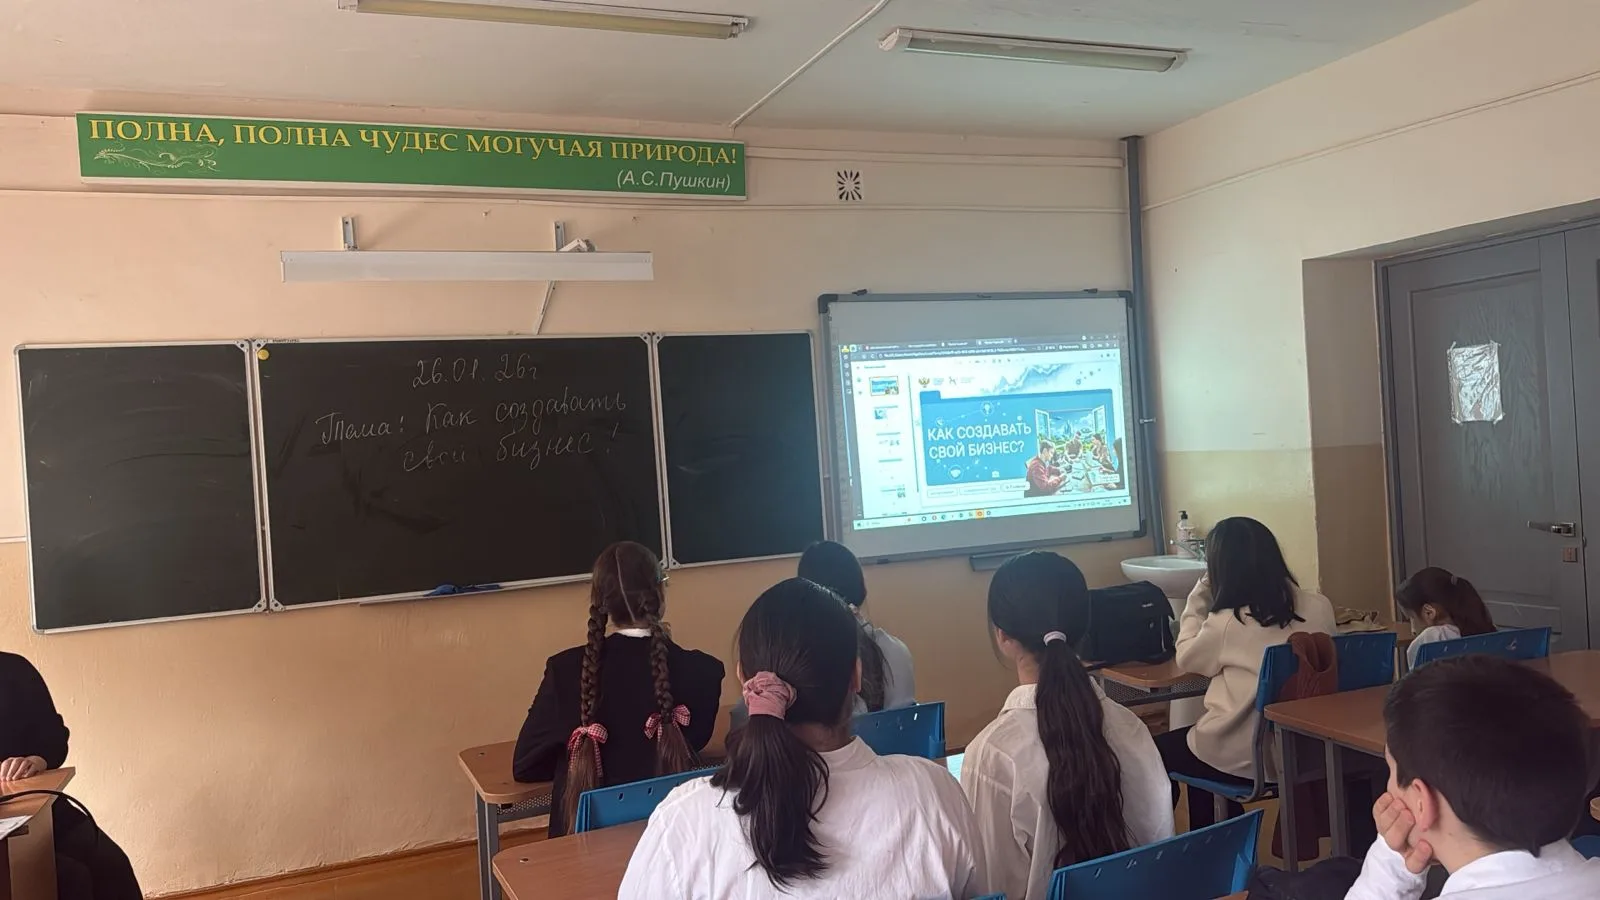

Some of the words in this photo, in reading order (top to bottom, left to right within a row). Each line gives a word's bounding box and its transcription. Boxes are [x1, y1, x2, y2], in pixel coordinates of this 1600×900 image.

[89, 119, 225, 147] ПОЛНА,
[232, 124, 351, 147] ПОЛНА
[358, 129, 458, 153] ЧУДЕС
[466, 134, 603, 160] МОГУЧАЯ
[610, 141, 737, 167] ПРИРОДА!
[616, 168, 731, 192] (А.С.Пушкин)
[426, 402, 478, 434] Как
[495, 386, 626, 436] создавать
[927, 427, 955, 441] КАК
[956, 422, 1032, 440] СОЗДАВАТЬ
[928, 441, 966, 460] СВОЙ
[968, 440, 1025, 457] БИЗНЕС?
